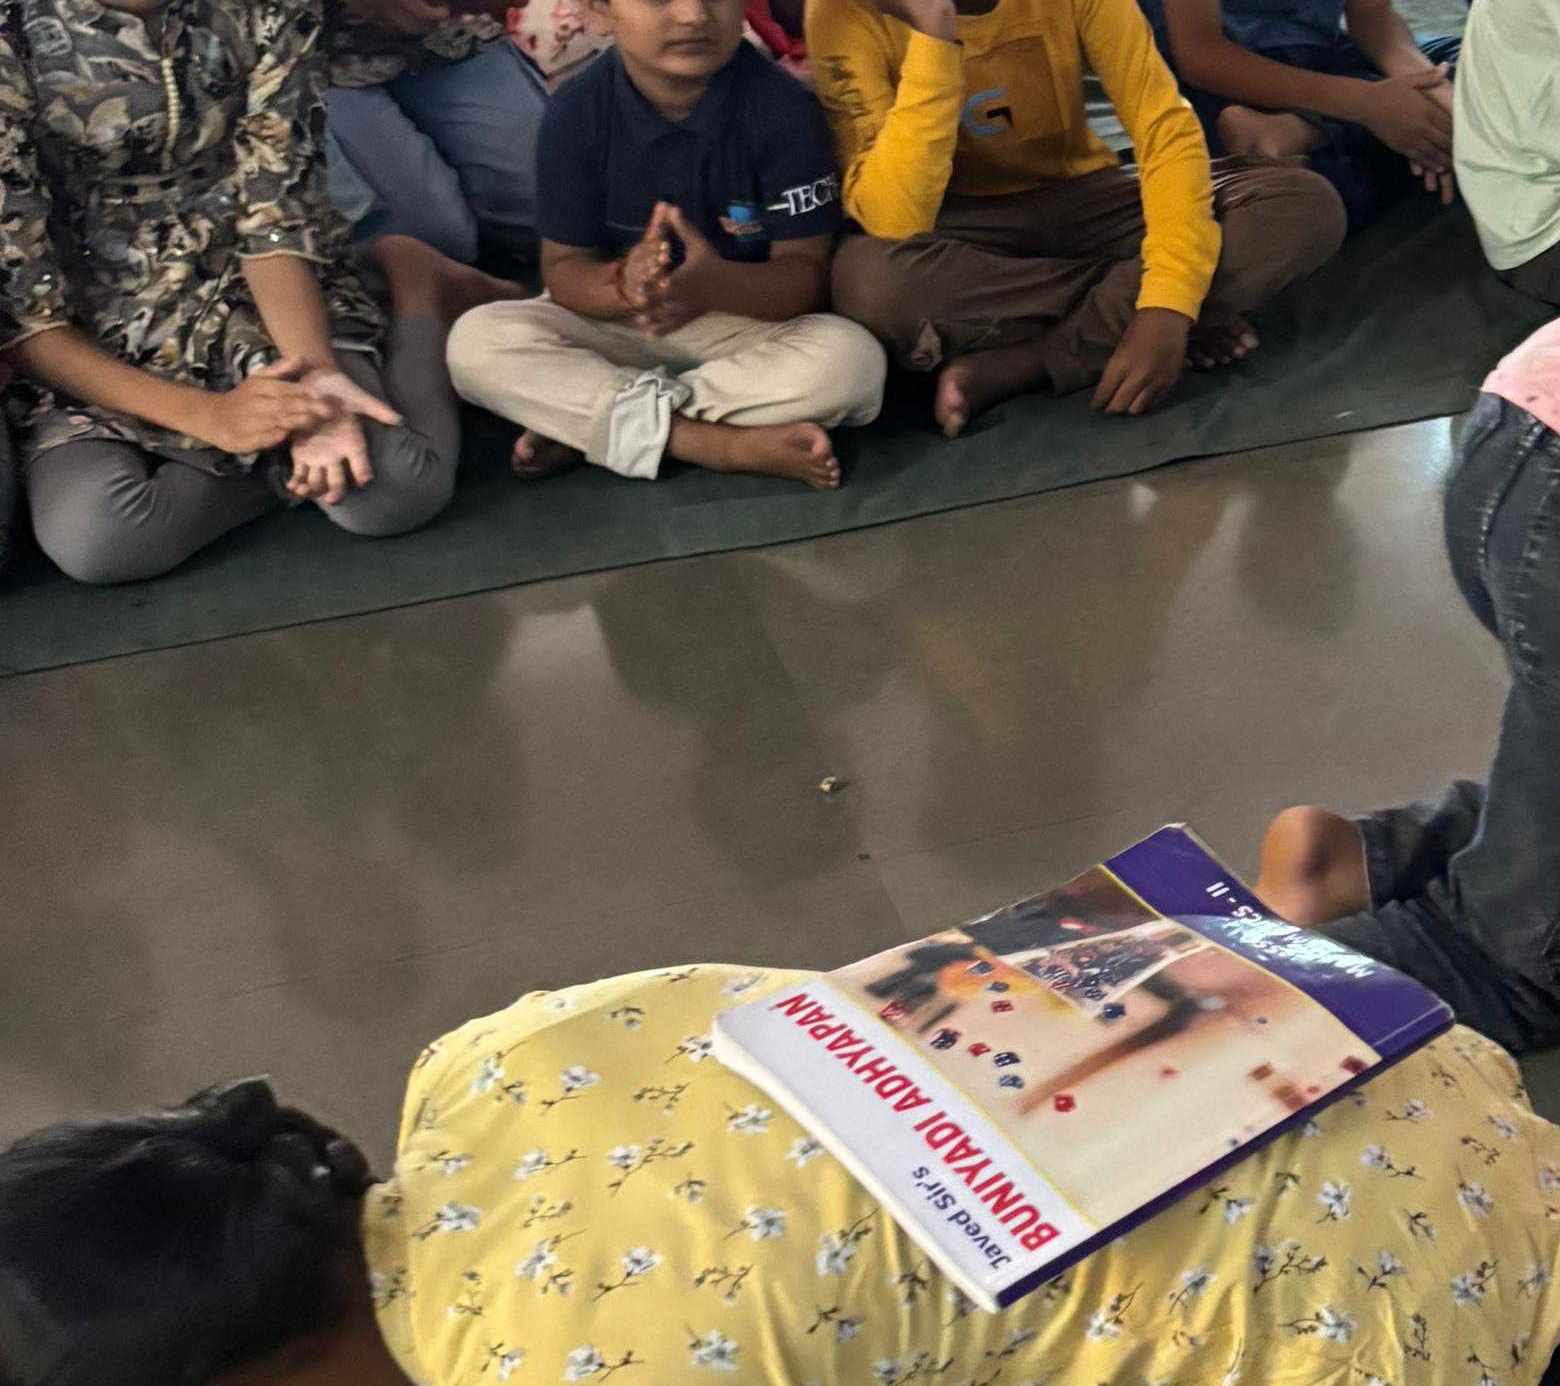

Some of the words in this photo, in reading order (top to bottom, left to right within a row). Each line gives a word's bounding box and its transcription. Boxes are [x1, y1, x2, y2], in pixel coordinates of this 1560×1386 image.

[1205, 881, 1231, 898] II
[774, 992, 934, 1114] ADHYAPAN
[911, 1165, 957, 1212] Sir's
[912, 1110, 1062, 1252] BUNIYADI
[947, 1208, 1012, 1270] Javed
